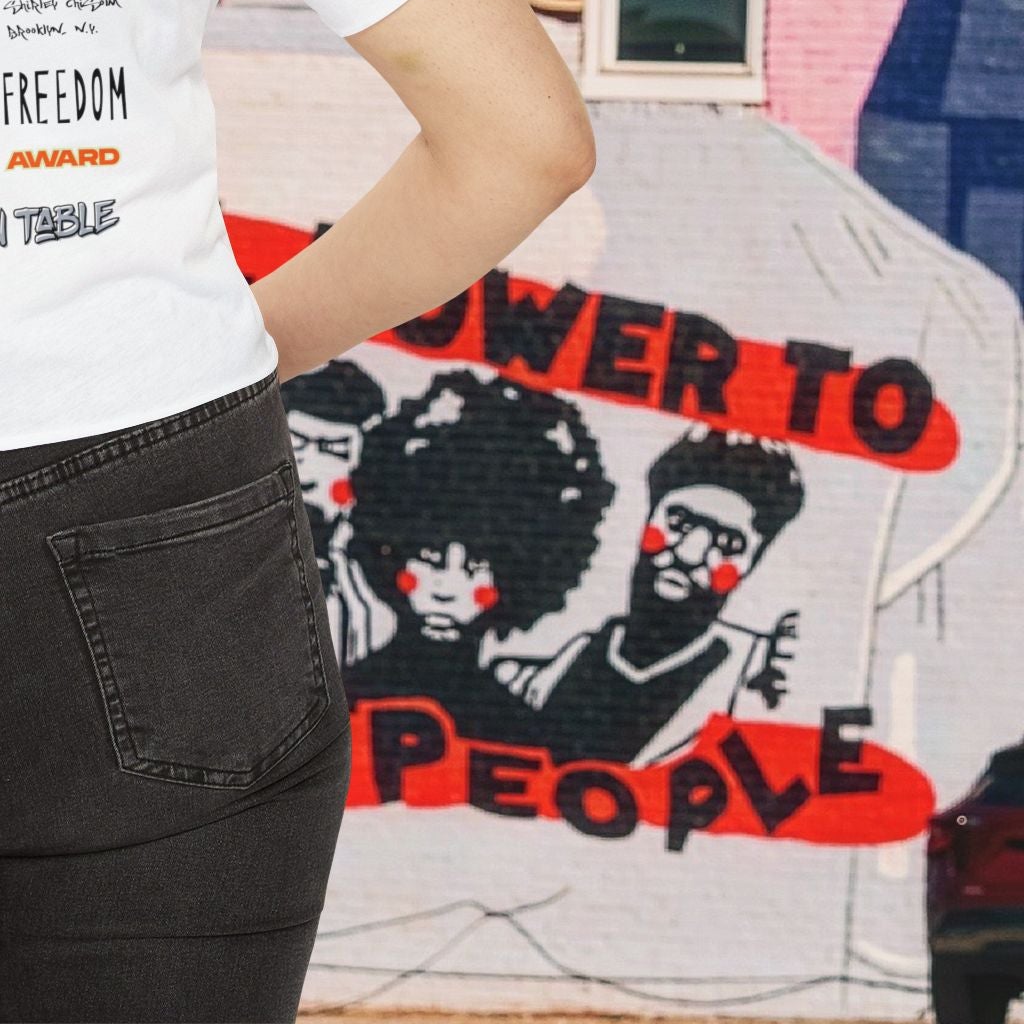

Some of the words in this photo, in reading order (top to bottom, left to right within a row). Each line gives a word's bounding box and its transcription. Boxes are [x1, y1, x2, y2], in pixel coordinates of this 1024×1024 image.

[3, 66, 127, 125] FREEDOM
[5, 147, 121, 171] AWARD
[13, 199, 121, 246] TABLE
[785, 339, 933, 455] TO
[371, 706, 880, 853] PEOPLE
